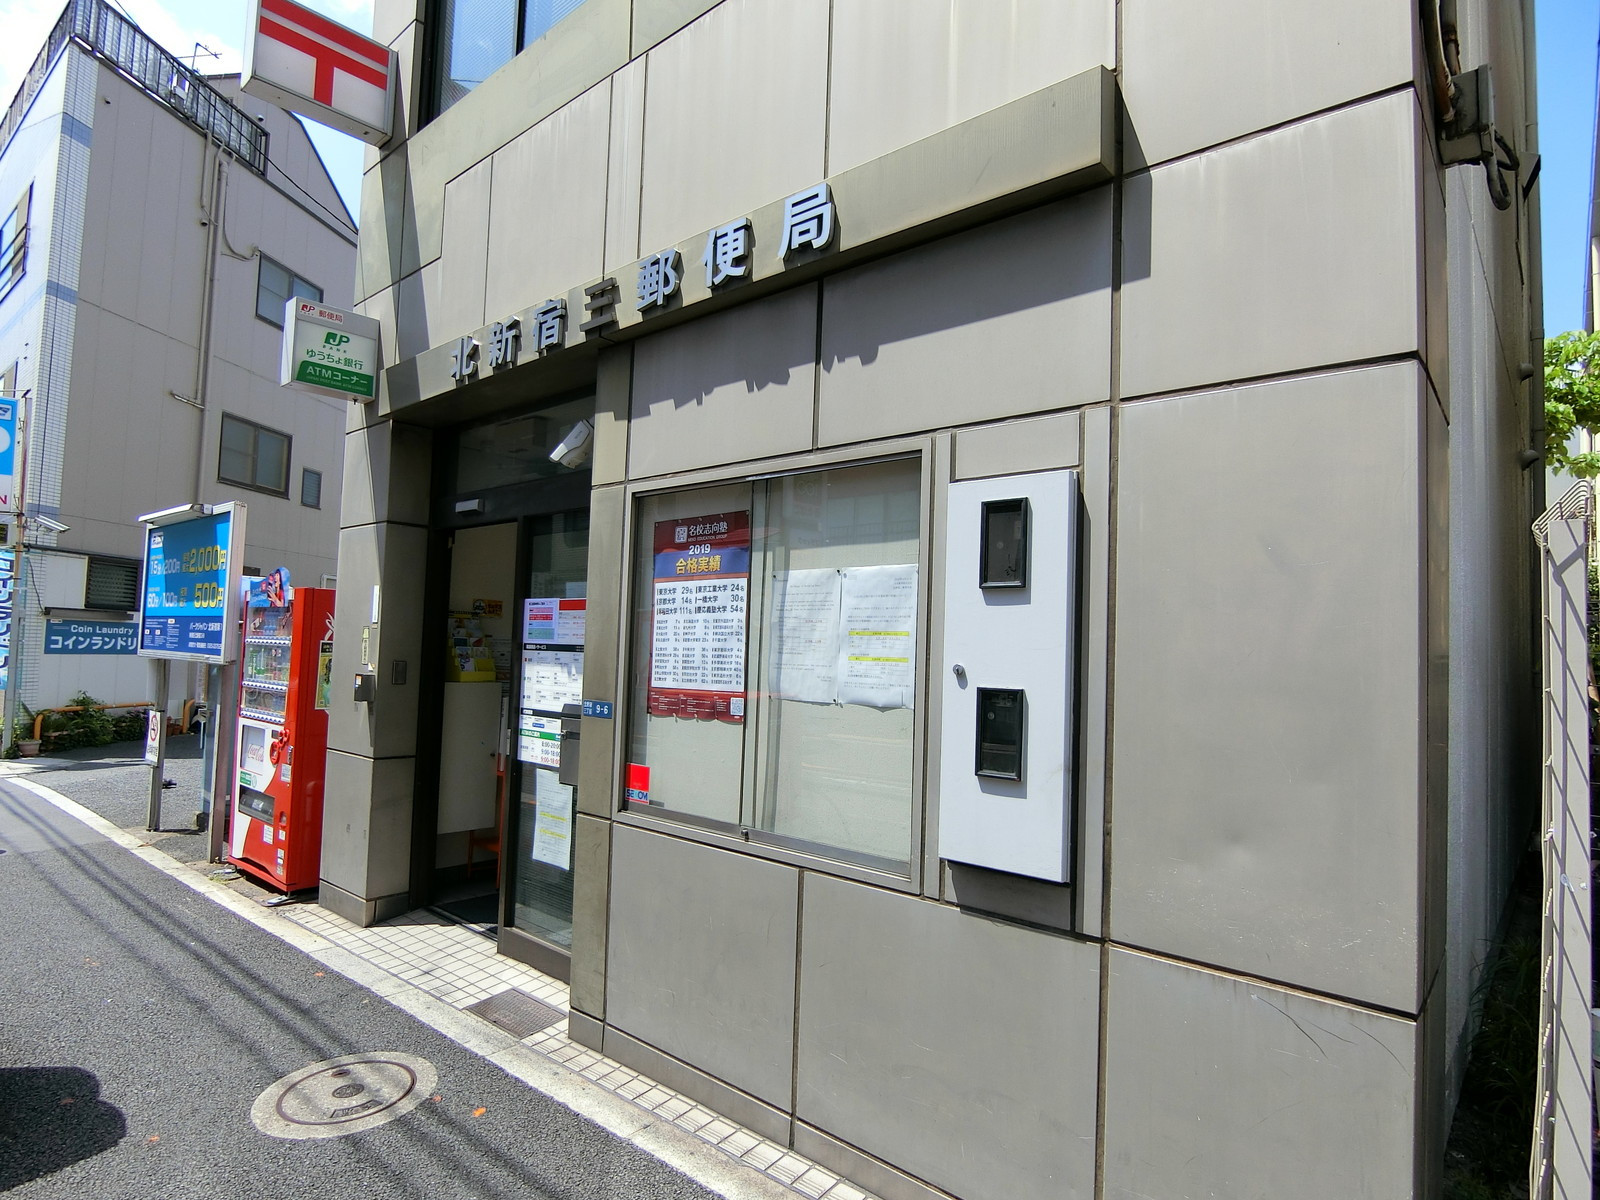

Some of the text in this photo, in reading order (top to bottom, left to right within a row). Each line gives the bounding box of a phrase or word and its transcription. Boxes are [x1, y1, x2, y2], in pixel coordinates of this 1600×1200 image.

[451, 182, 834, 381] 北新宿三郵便局
[301, 304, 315, 312] JP
[319, 310, 343, 323] 郵便局
[324, 332, 350, 346] JP
[306, 348, 364, 370] ゆうちょ銀行
[306, 366, 368, 384] ATMコーナー
[688, 521, 728, 537] 名校志向塾
[688, 543, 711, 555] 2019
[189, 544, 227, 576] 2,000円
[675, 554, 722, 575] 合格実績
[194, 581, 224, 608] 500円
[730, 583, 744, 592] 24名
[730, 605, 744, 614] 54名
[71, 625, 134, 635] Coin Laundry
[596, 704, 609, 715] 9-6
